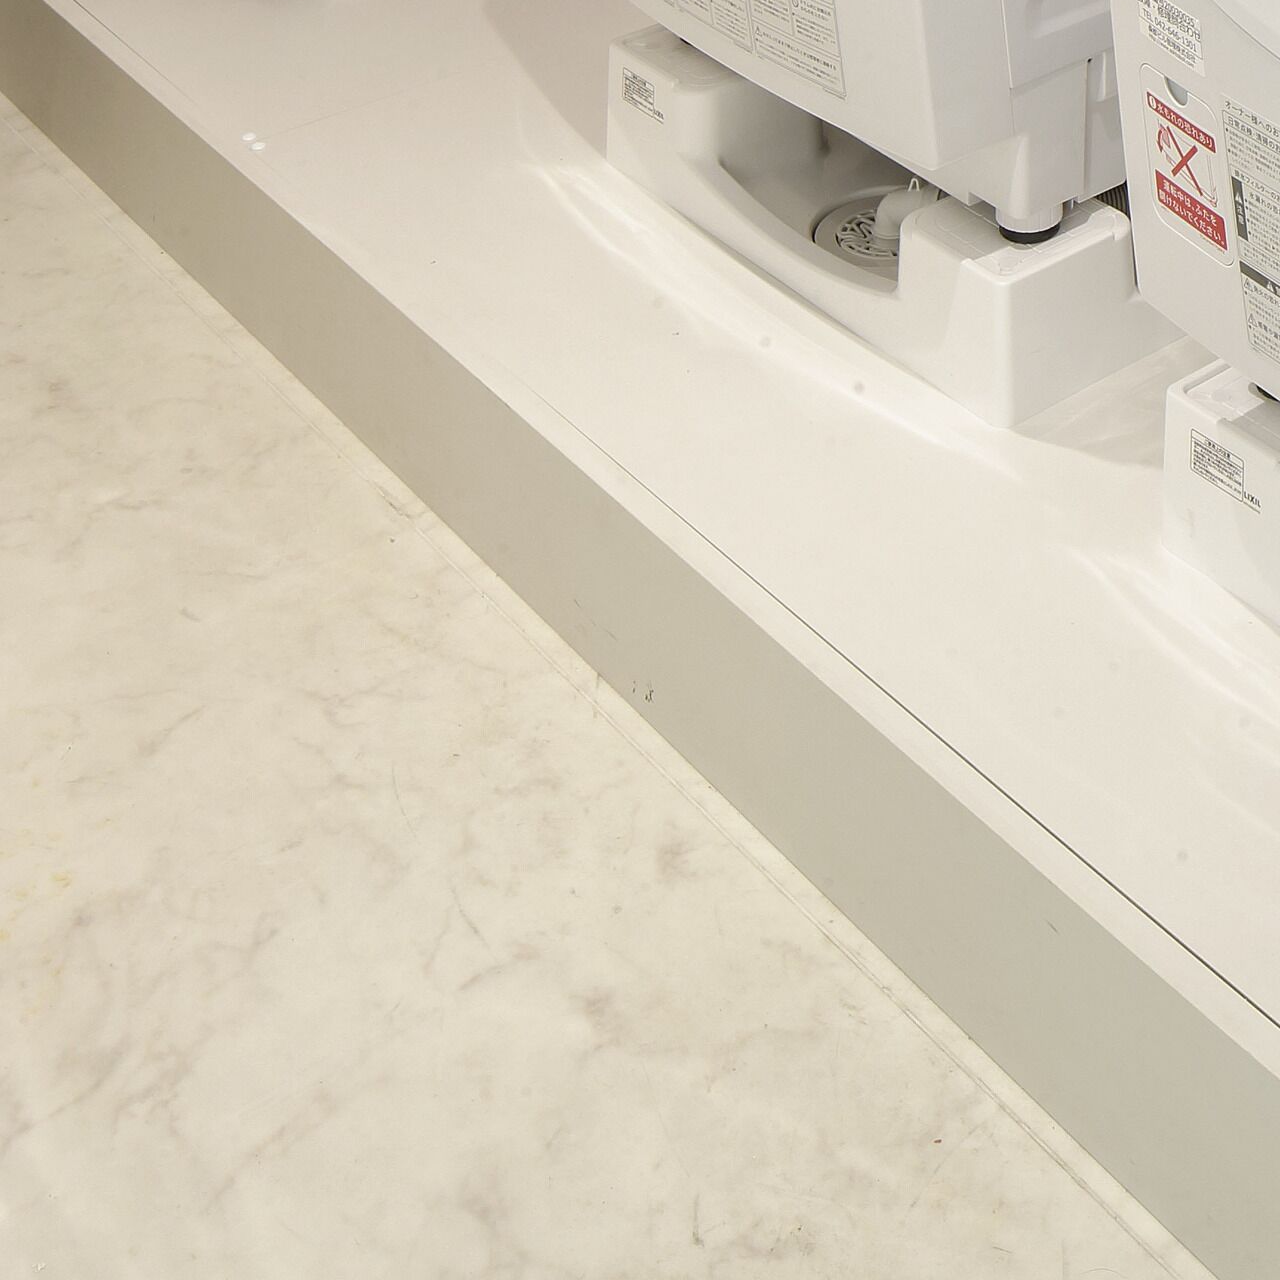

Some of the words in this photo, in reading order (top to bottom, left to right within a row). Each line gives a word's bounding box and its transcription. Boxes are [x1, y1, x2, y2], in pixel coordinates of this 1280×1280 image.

[1157, 103, 1213, 148] 水もれの恐れあり
[1158, 189, 1225, 246] 開けないでください。
[1163, 179, 1217, 226] 運転中は、ふたを
